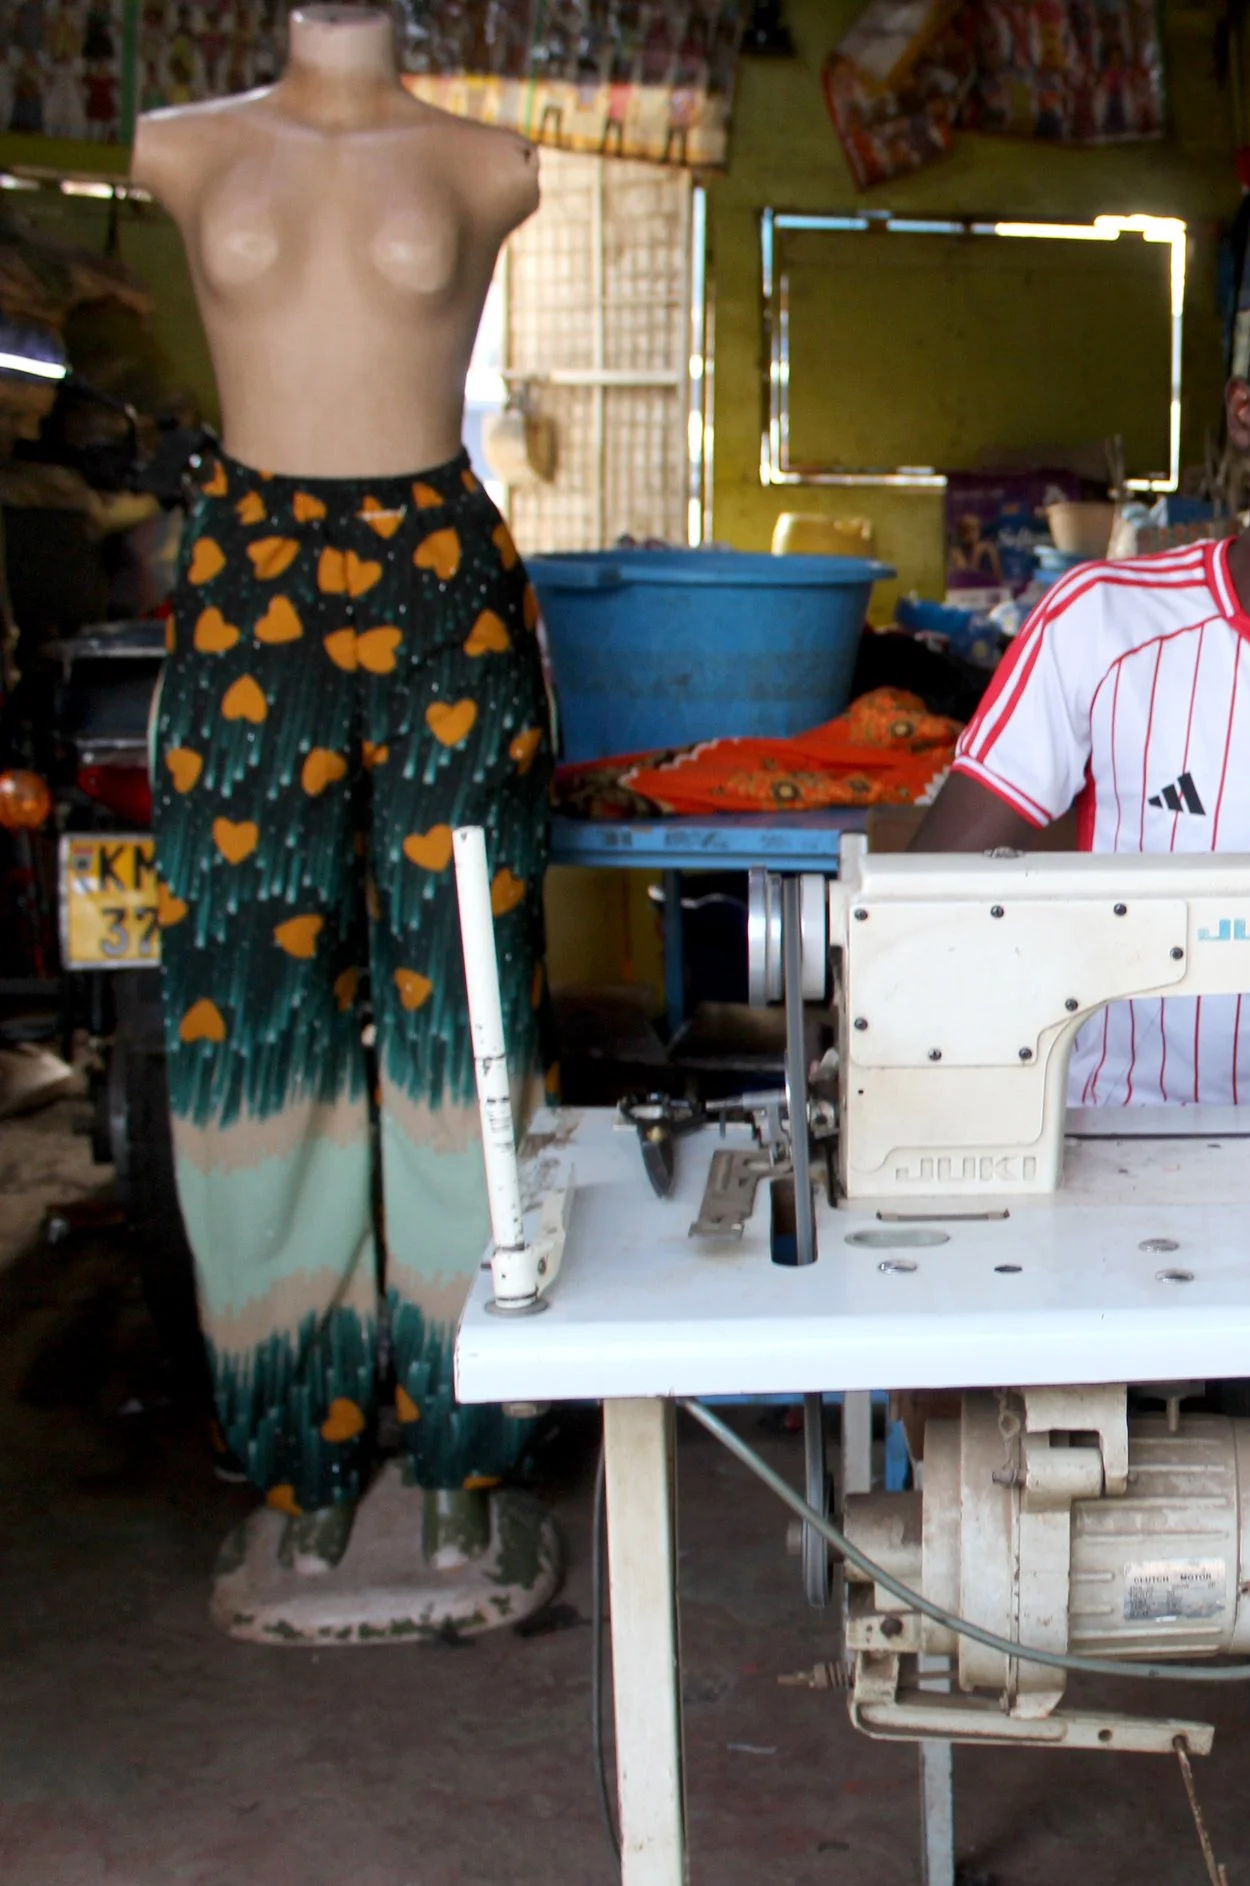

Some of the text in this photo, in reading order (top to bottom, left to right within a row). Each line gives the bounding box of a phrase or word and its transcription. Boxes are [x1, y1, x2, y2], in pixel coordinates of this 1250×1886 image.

[895, 1156, 1037, 1181] JUKI
[1133, 1573, 1212, 1584] CLUTCH MOTOR
